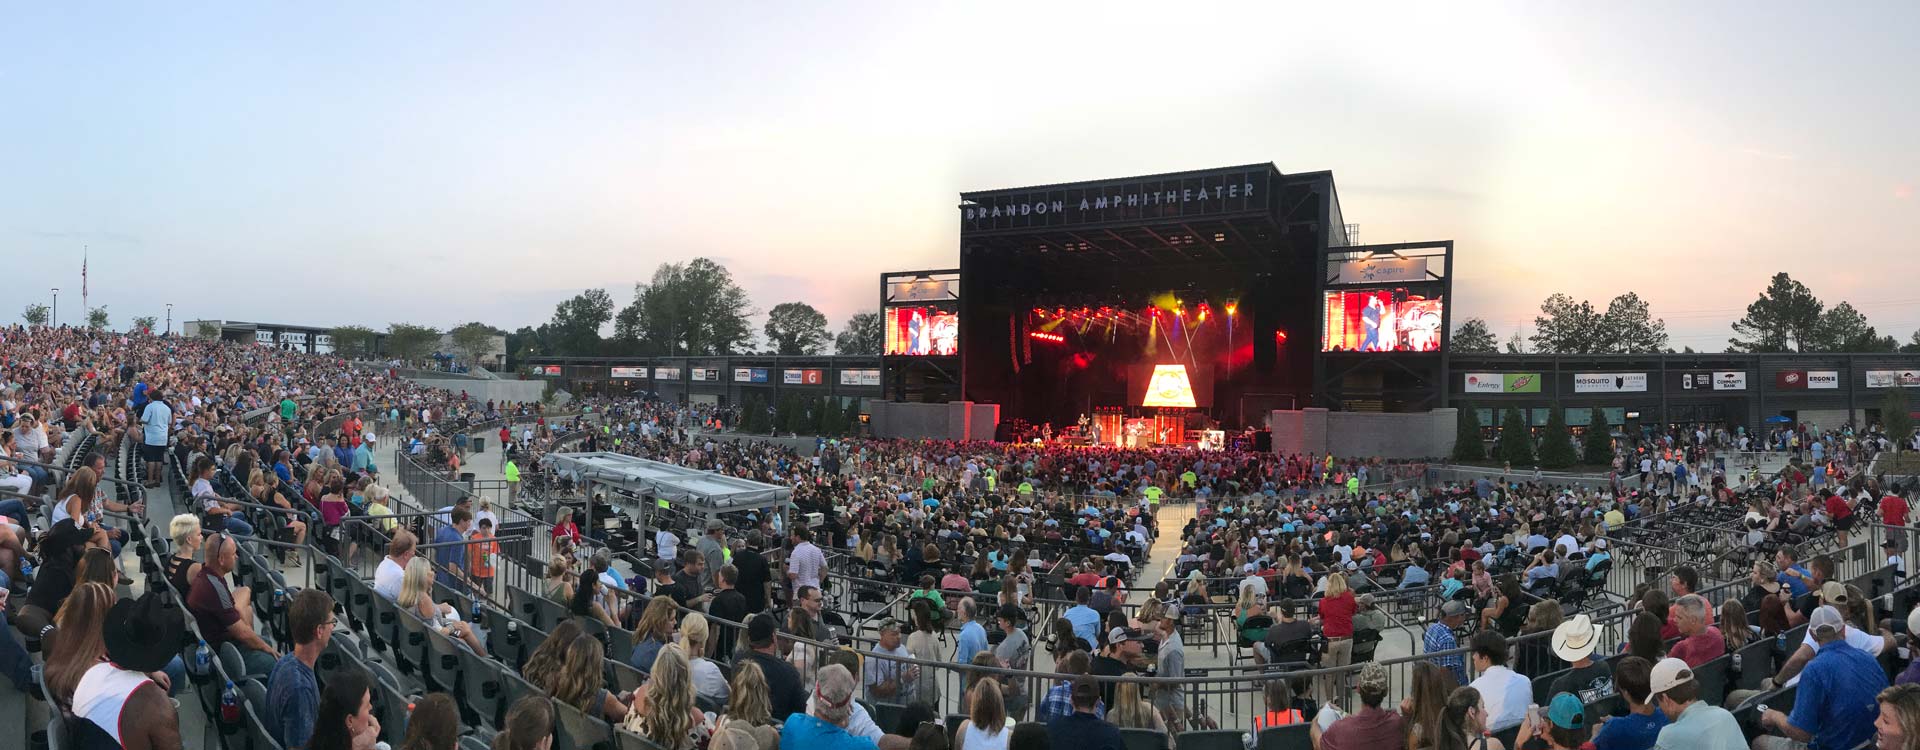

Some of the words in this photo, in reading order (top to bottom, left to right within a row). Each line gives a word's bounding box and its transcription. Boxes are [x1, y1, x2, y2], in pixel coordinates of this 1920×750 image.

[966, 200, 1062, 220] BRANDON
[1080, 183, 1254, 211] AMPHITHEATER
[808, 372, 816, 384] G
